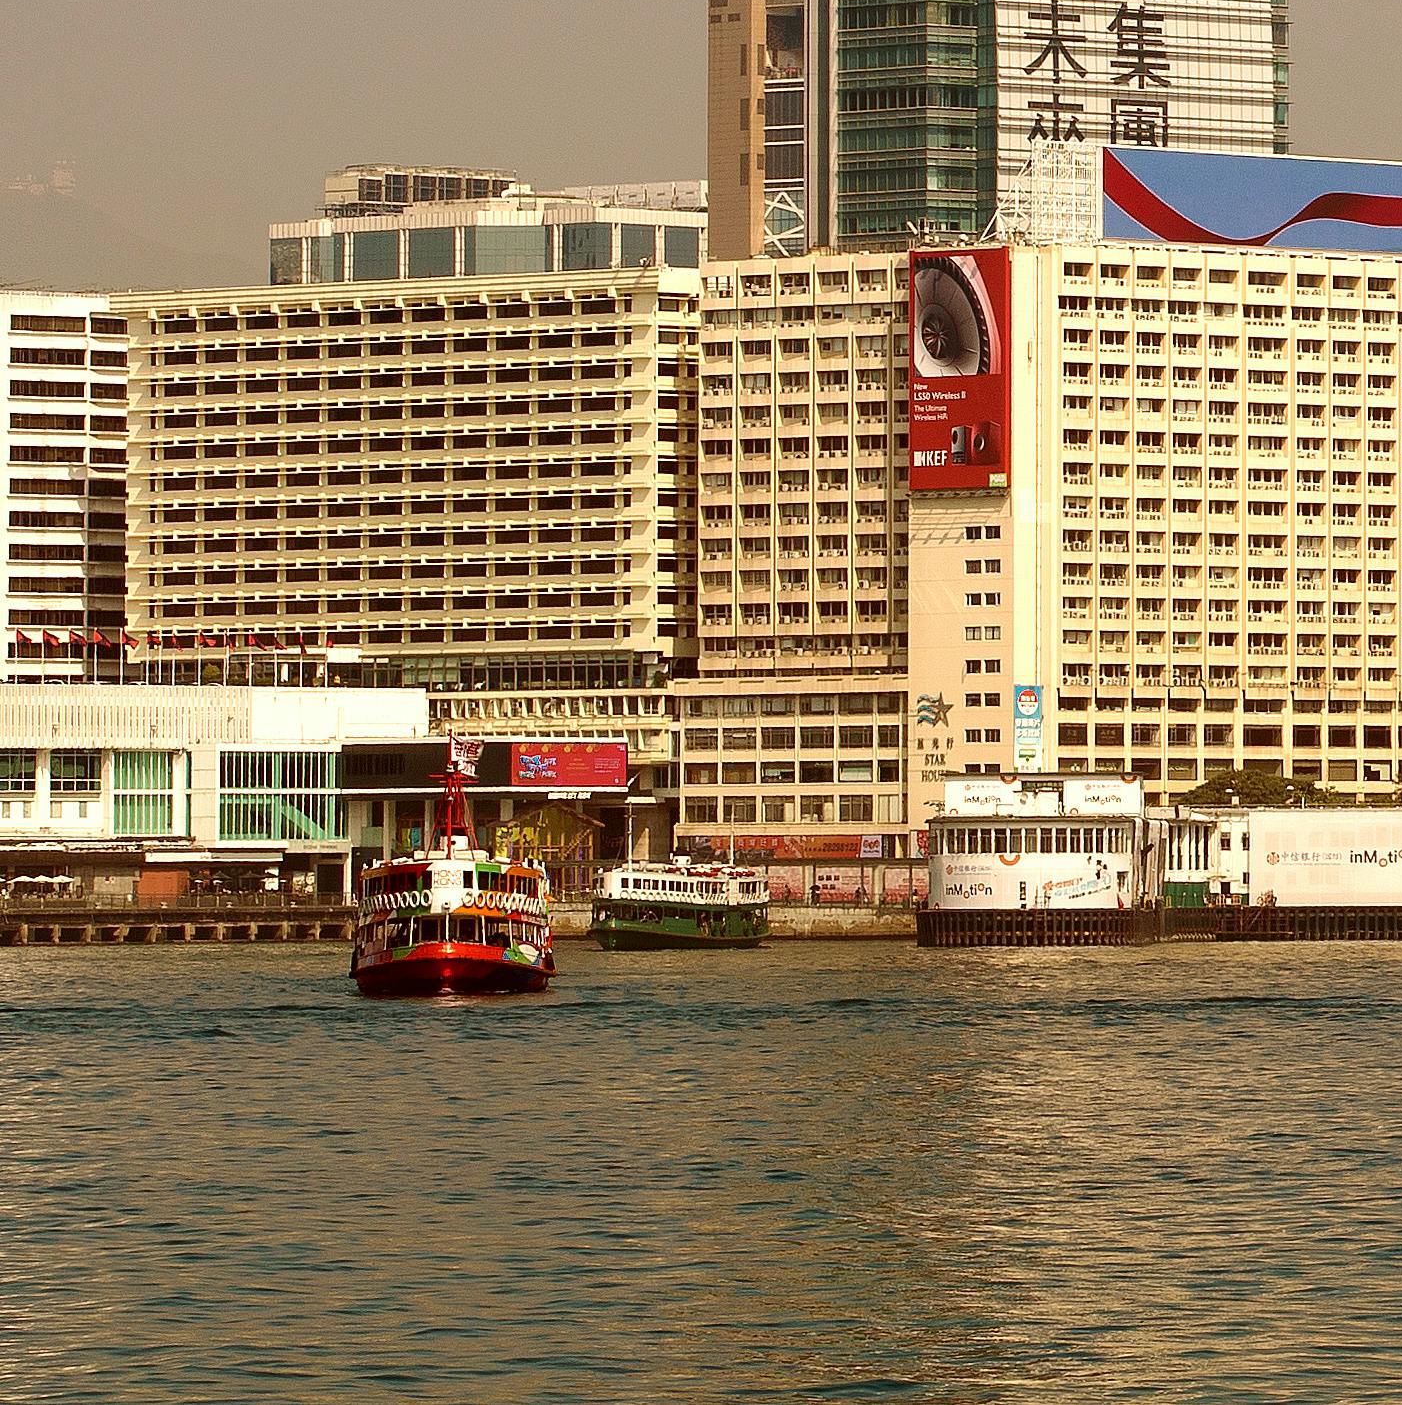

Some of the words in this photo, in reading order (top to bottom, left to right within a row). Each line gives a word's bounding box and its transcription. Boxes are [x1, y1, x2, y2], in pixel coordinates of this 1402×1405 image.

[926, 450, 948, 467] KEF
[924, 753, 947, 766] STAR
[921, 769, 945, 783] HOUS
[433, 869, 462, 878] HONG
[433, 878, 462, 886] KONG
[945, 882, 993, 899] inMotion
